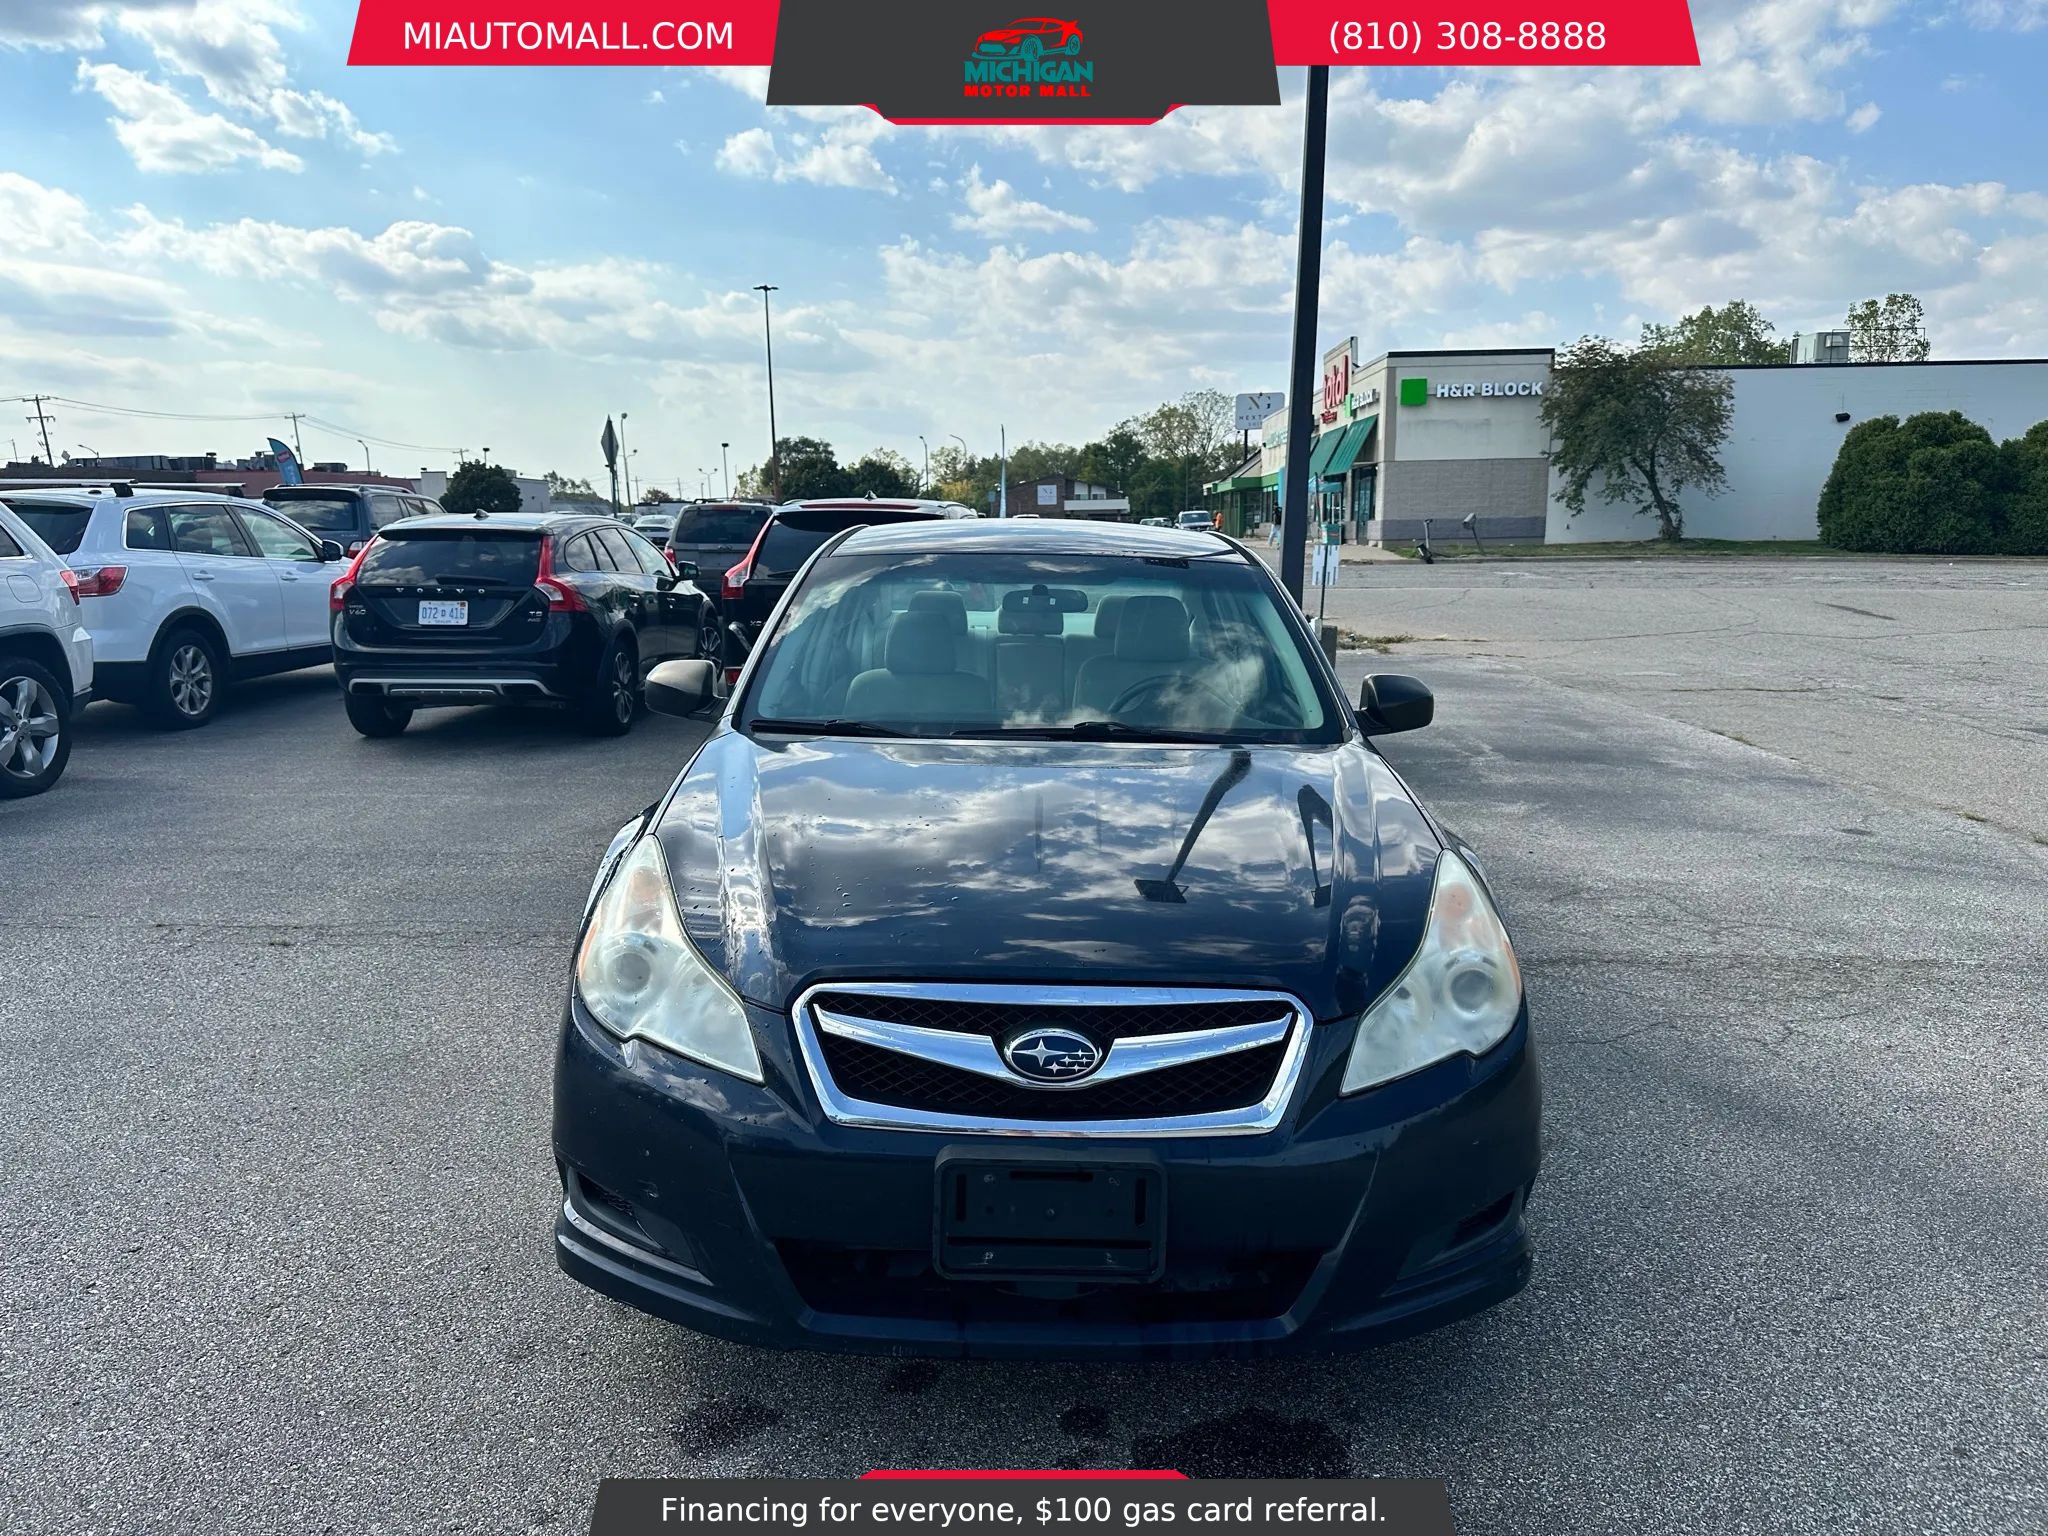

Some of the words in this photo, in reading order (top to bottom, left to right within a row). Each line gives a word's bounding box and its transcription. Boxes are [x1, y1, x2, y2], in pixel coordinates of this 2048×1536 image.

[1436, 383, 1476, 398] H&R
[1481, 381, 1543, 396] BLOCK
[421, 606, 438, 620] 072
